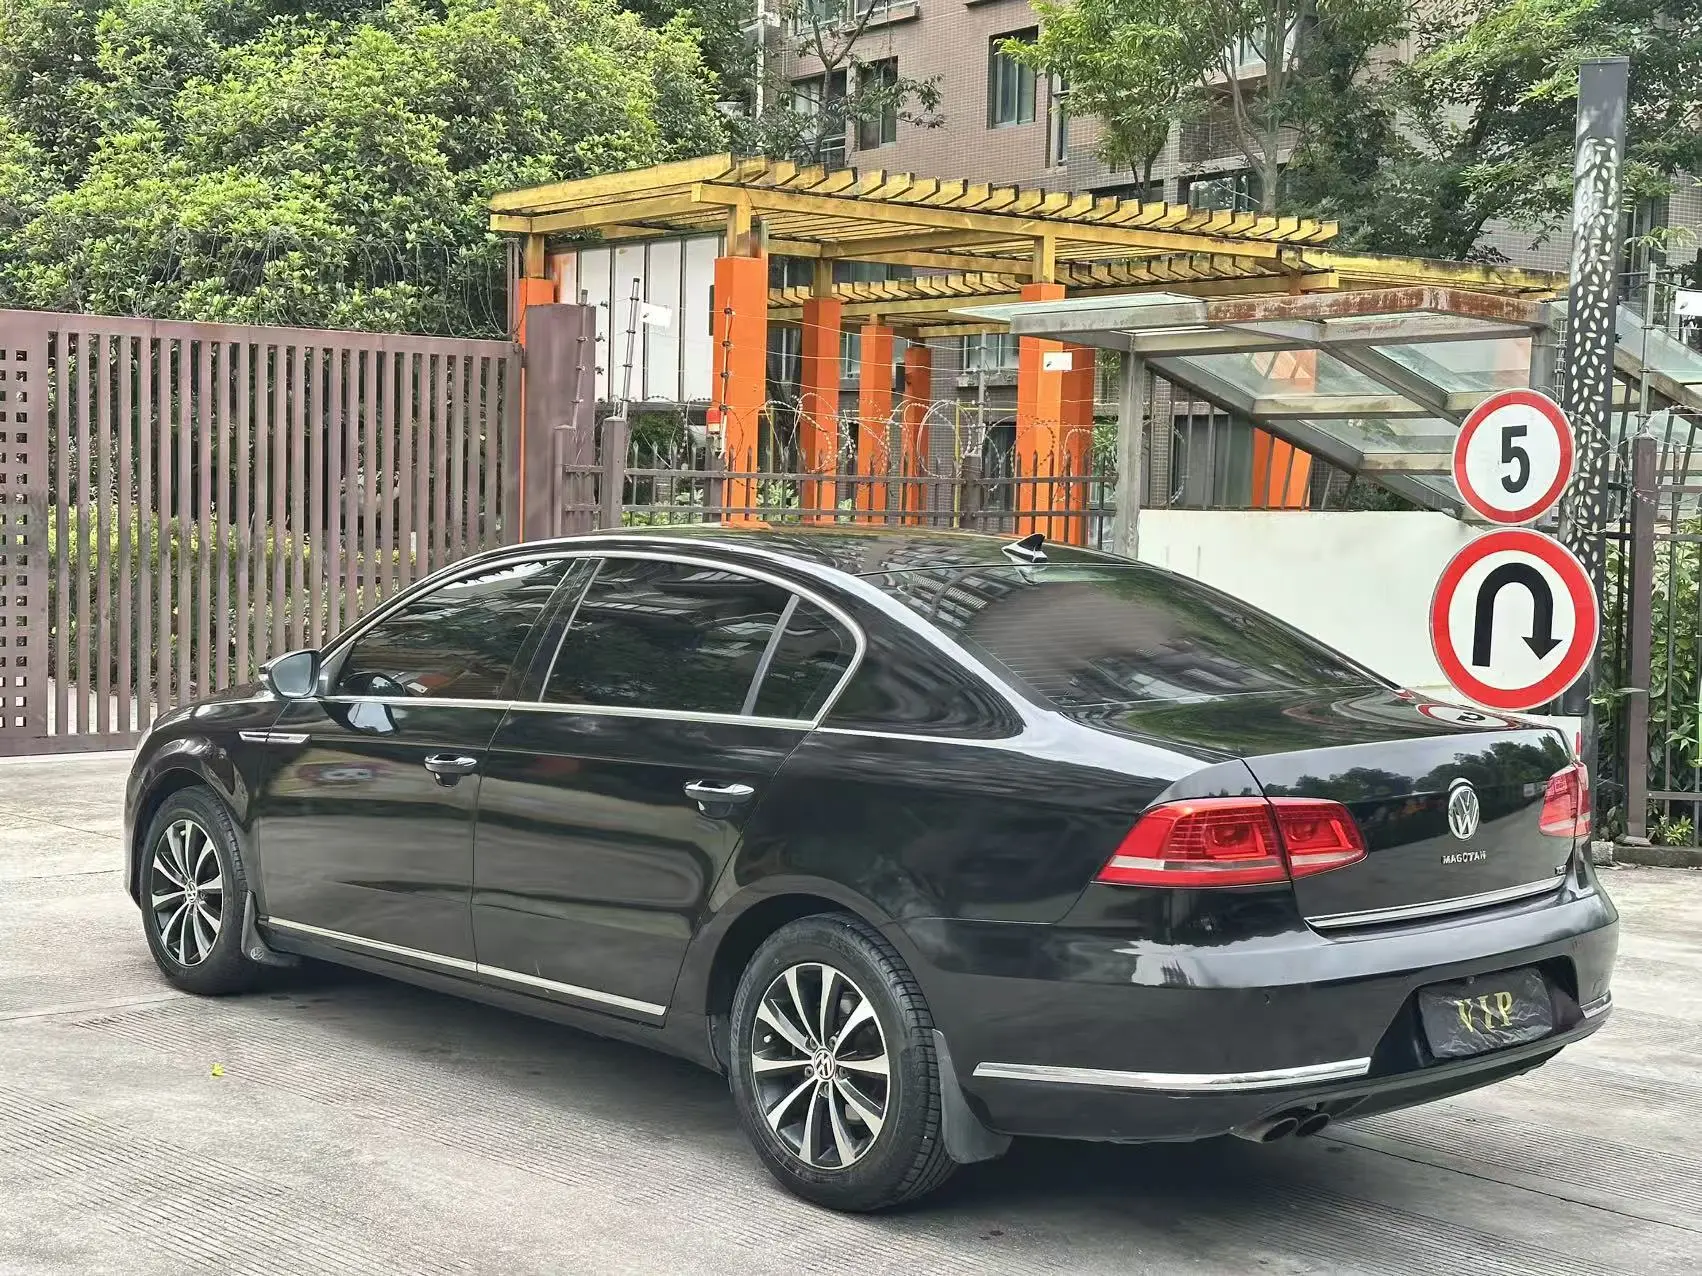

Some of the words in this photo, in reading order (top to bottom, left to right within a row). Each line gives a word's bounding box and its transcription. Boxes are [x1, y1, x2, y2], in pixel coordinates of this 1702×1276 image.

[1501, 425, 1530, 493] 5
[1442, 850, 1487, 864] MAGOTAN
[1453, 991, 1513, 1033] VIP
